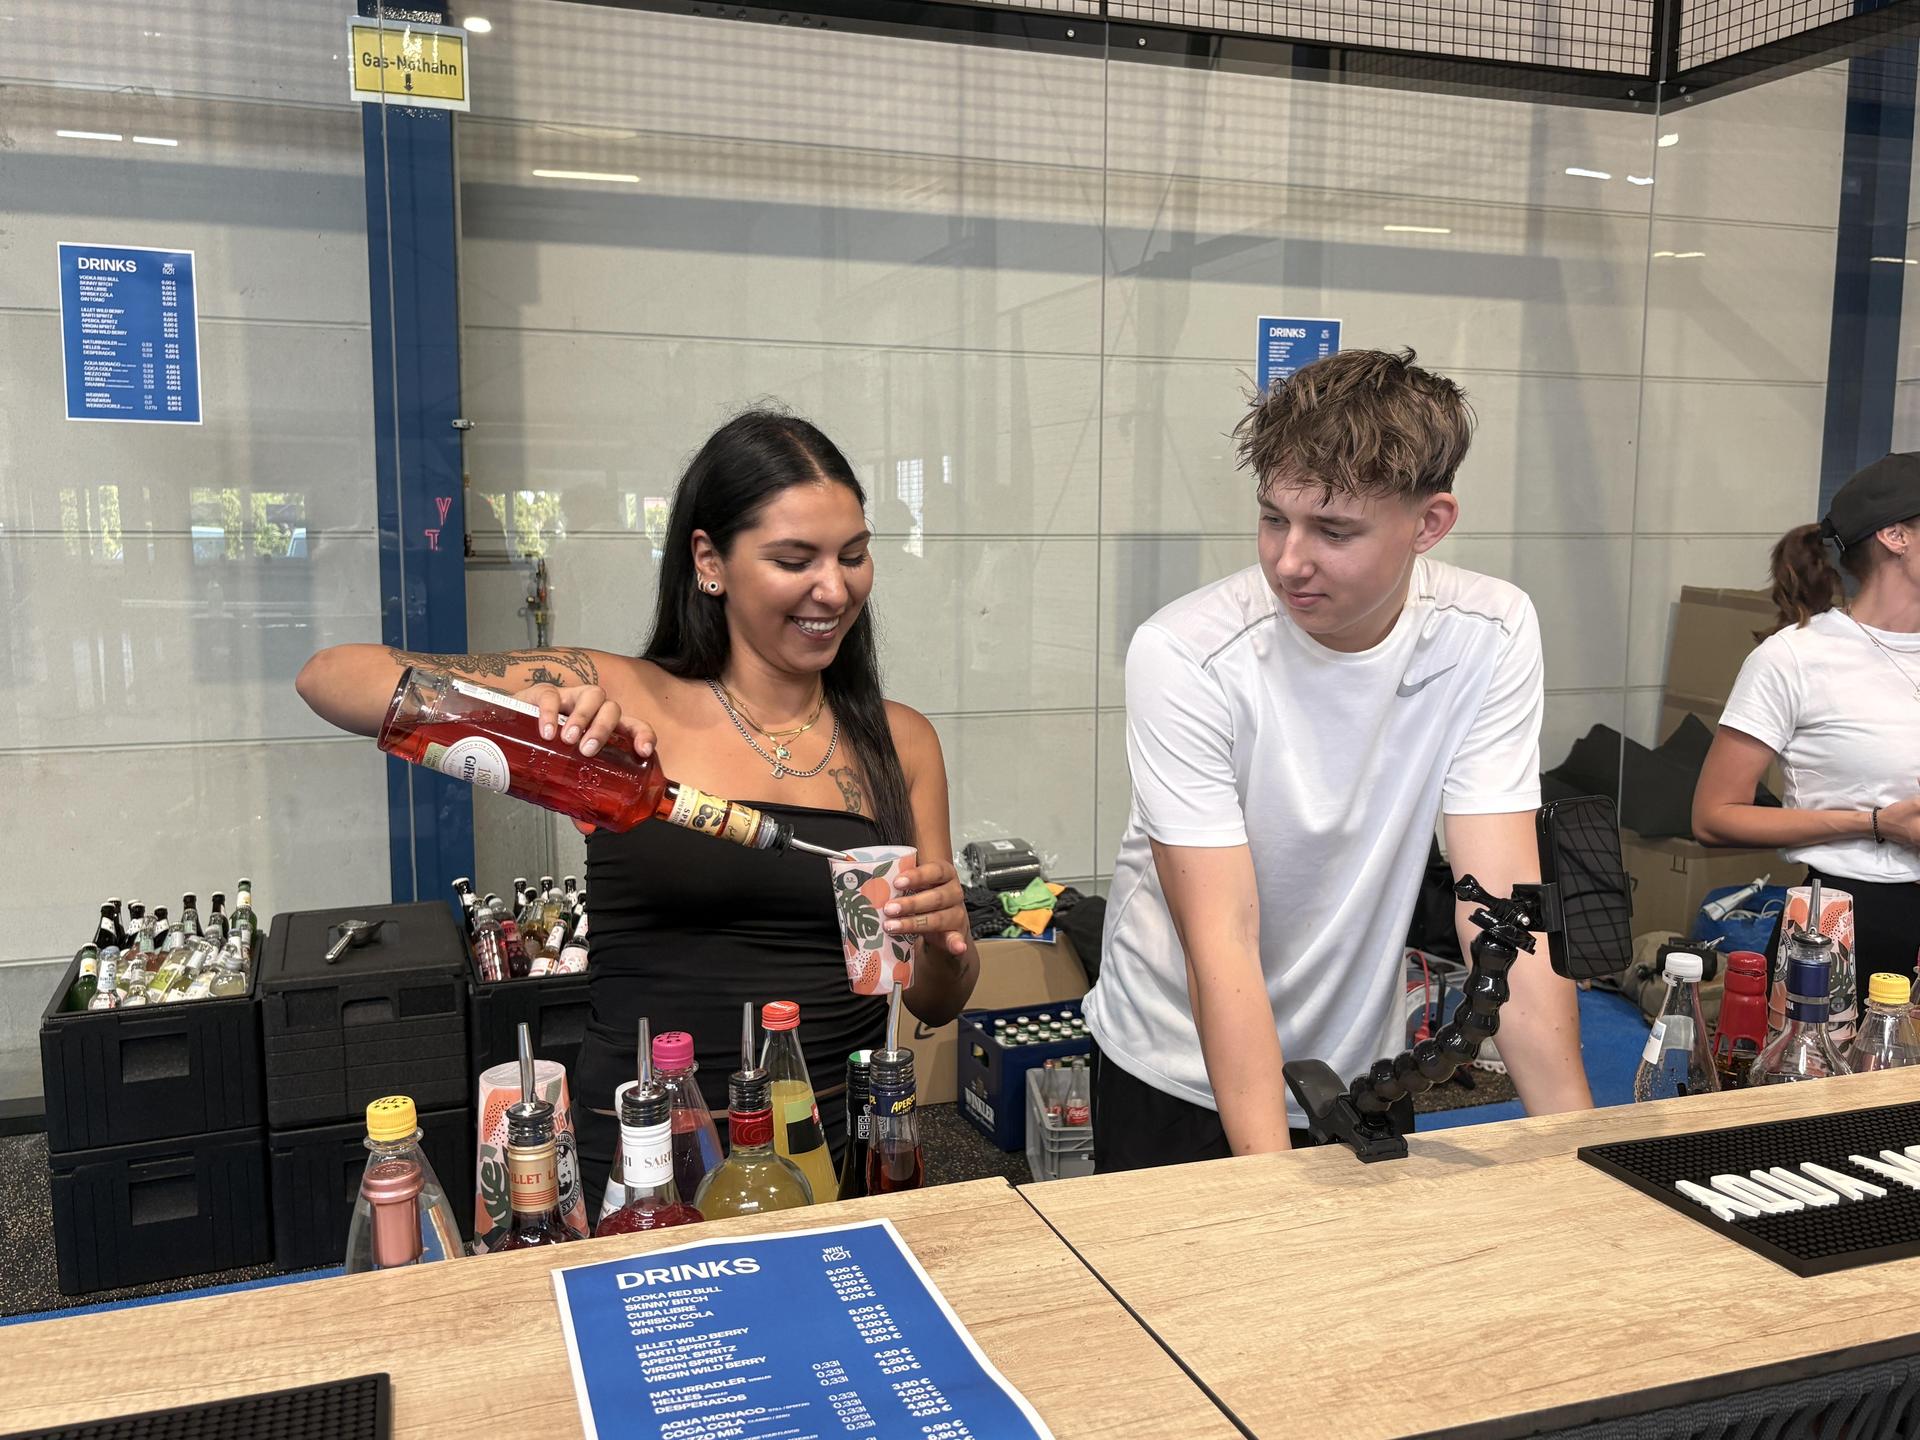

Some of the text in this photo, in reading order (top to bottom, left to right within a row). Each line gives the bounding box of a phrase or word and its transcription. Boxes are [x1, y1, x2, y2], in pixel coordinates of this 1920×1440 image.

[78, 257, 136, 272] DRINKS
[1269, 328, 1306, 338] DRINKS
[890, 1094, 915, 1113] APERO
[644, 1151, 672, 1168] SART
[1675, 1162, 1887, 1222] AQUA
[822, 1246, 844, 1254] WHY
[616, 1258, 760, 1290] DRINKS
[622, 1290, 667, 1303] VODKA
[668, 1289, 692, 1298] RED
[694, 1286, 723, 1295] BULL
[625, 1298, 670, 1311] SKINNY
[672, 1296, 708, 1305] BITCH
[627, 1310, 662, 1320] CUBA
[664, 1305, 696, 1315] LIBRE
[628, 1315, 677, 1328] WHISKY
[680, 1311, 714, 1320] COLA
[631, 1326, 654, 1336] GIN
[656, 1321, 694, 1332] TONIC
[636, 1340, 674, 1352] LILLET
[676, 1334, 708, 1345] WILD
[709, 1328, 749, 1339] BERRY
[638, 1348, 676, 1359] SARTI
[677, 1340, 722, 1352] SPRITZ
[640, 1354, 691, 1367] APEROL
[693, 1345, 738, 1358] SPRITZ
[642, 1362, 687, 1375] VIRGIN
[688, 1354, 734, 1367] SPRITZ
[644, 1370, 690, 1383] VIRGIN
[689, 1364, 723, 1375] WILD
[725, 1356, 766, 1369] BERRY
[650, 1377, 746, 1399] NATURRADLER
[874, 1349, 899, 1359] 4,20
[652, 1393, 702, 1406] HELLES
[878, 1357, 904, 1367] 4,20
[654, 1394, 747, 1414] DESPERADOS
[882, 1364, 910, 1375] 5,00
[660, 1418, 700, 1431] AQUA
[701, 1407, 766, 1423] MONACO
[892, 1380, 919, 1390] 3,80
[662, 1424, 705, 1440] COCA
[706, 1418, 746, 1430] COLA
[898, 1387, 924, 1397] 4,00
[907, 1400, 935, 1410] 4,90
[912, 1407, 940, 1417] 4,00
[717, 1427, 744, 1438] MIX
[902, 1393, 930, 1402] 4,00
[922, 1422, 951, 1432] 6,90
